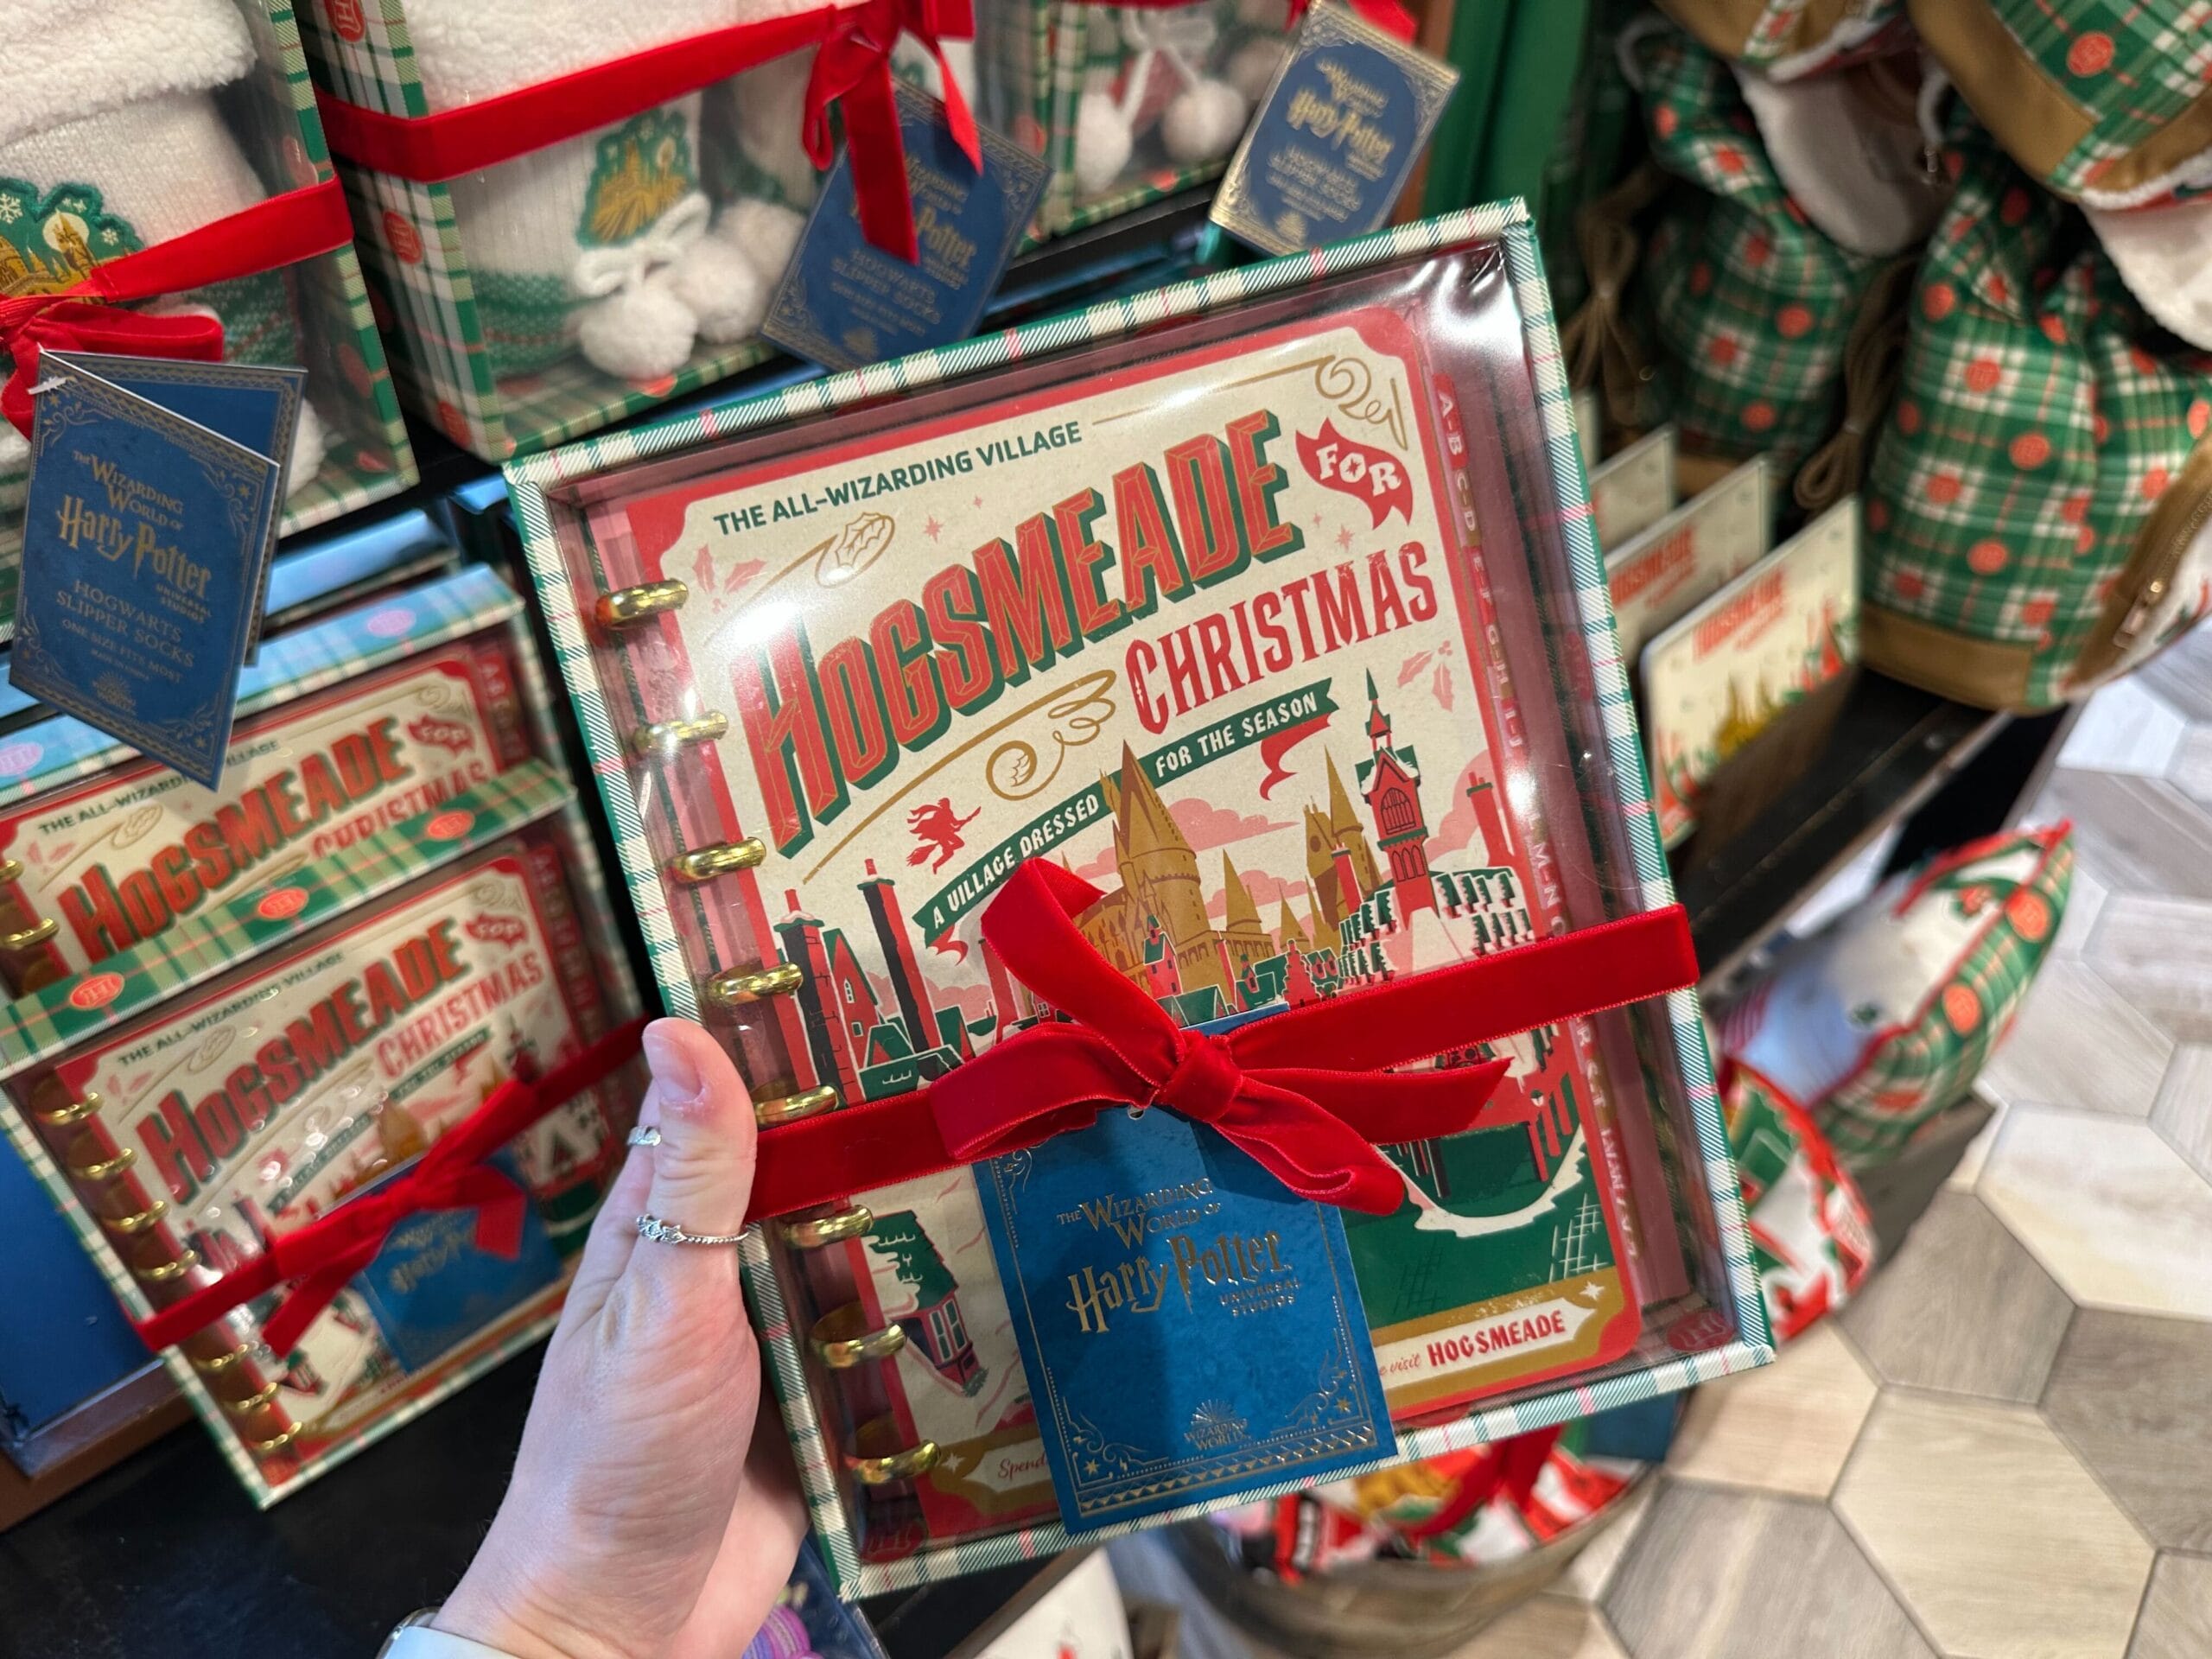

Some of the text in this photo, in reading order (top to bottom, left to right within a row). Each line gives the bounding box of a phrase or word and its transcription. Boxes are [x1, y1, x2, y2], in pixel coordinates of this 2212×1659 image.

[90, 454, 184, 515] WIZARDING
[713, 420, 1083, 536] THE ALL-WIZARDING VILLAGE
[1315, 442, 1403, 499] FOR
[107, 484, 168, 526] WORLD
[56, 494, 212, 599] Harry Potter
[56, 589, 194, 668] SLIPPER SOCKS
[74, 578, 182, 643] HOGWARTS
[728, 409, 1305, 859] HOGSMEADE
[1125, 540, 1439, 734] CHRISTMAS
[62, 618, 86, 637] ONE
[149, 660, 184, 683] MOST
[39, 817, 73, 836] THE
[56, 715, 415, 965] HOGSMEADE
[932, 690, 1319, 930] A VILLAGE DRESSED FOR THE SEASON
[118, 1043, 149, 1065] THE
[283, 952, 345, 987] VILLAGE
[377, 950, 544, 1077] CHRISTMAS
[136, 916, 472, 1205] HOGSMEADE
[1057, 1178, 1213, 1232] THE WIZARDING
[1110, 1202, 1221, 1250] WORLD OF
[1065, 1230, 1285, 1334] Harry Potter
[1218, 1277, 1300, 1306] UNIVERSAL
[1231, 1295, 1295, 1319] STUDIOS
[1389, 1309, 1566, 1375] visit HOGSMEADE
[998, 1451, 1046, 1481] Spend
